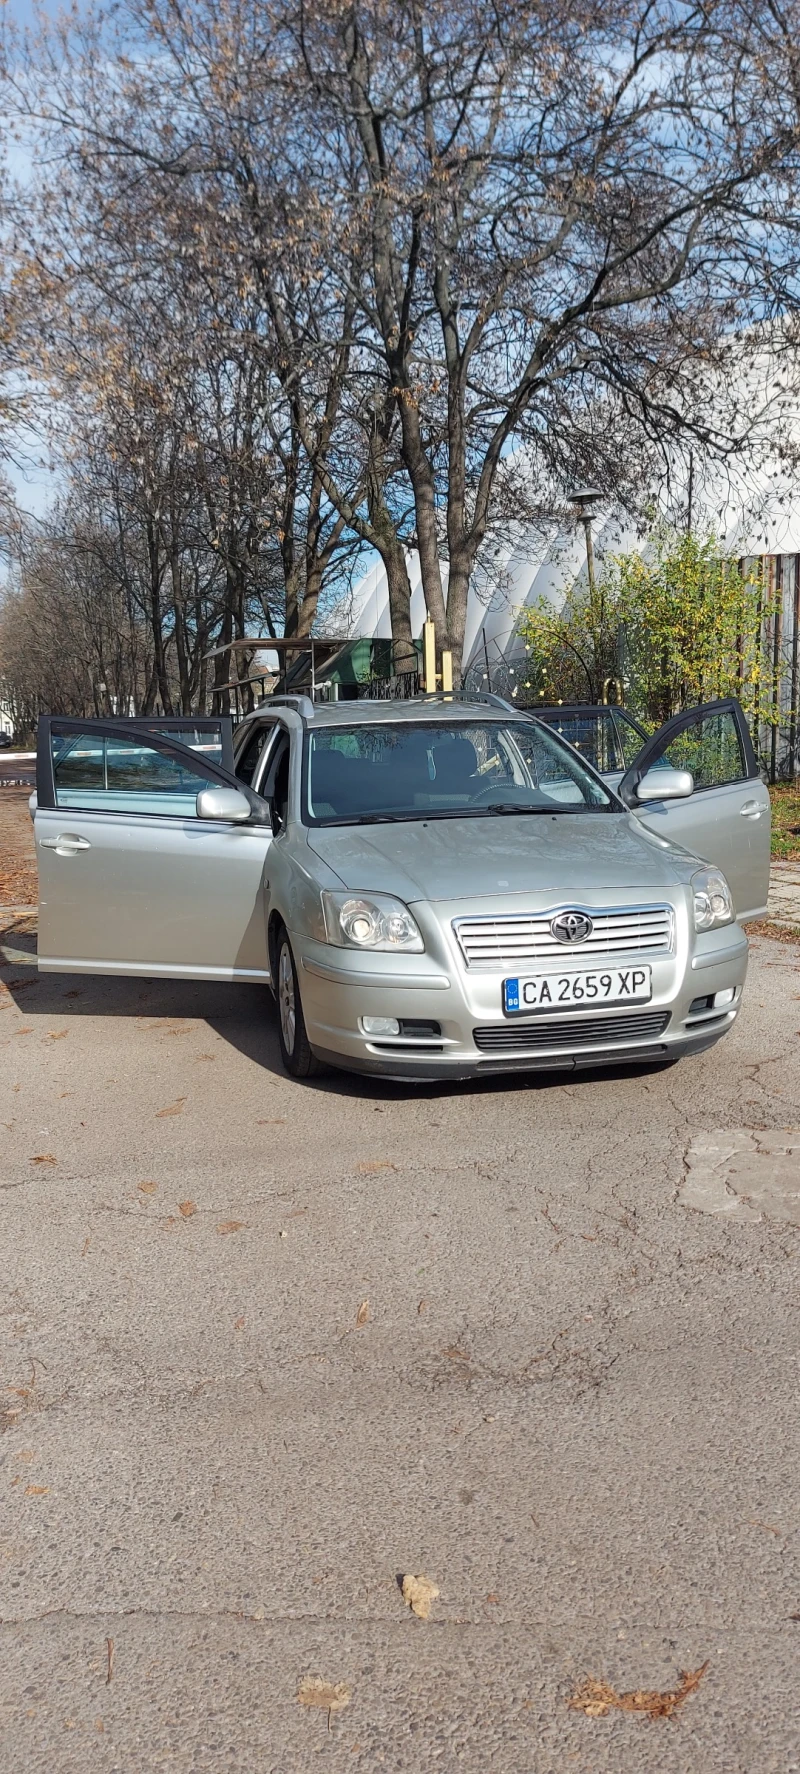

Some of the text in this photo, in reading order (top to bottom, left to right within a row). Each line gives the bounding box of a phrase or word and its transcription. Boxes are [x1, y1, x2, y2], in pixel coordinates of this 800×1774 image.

[522, 970, 646, 1004] CA 2659 XP
[508, 998, 518, 1006] BG
